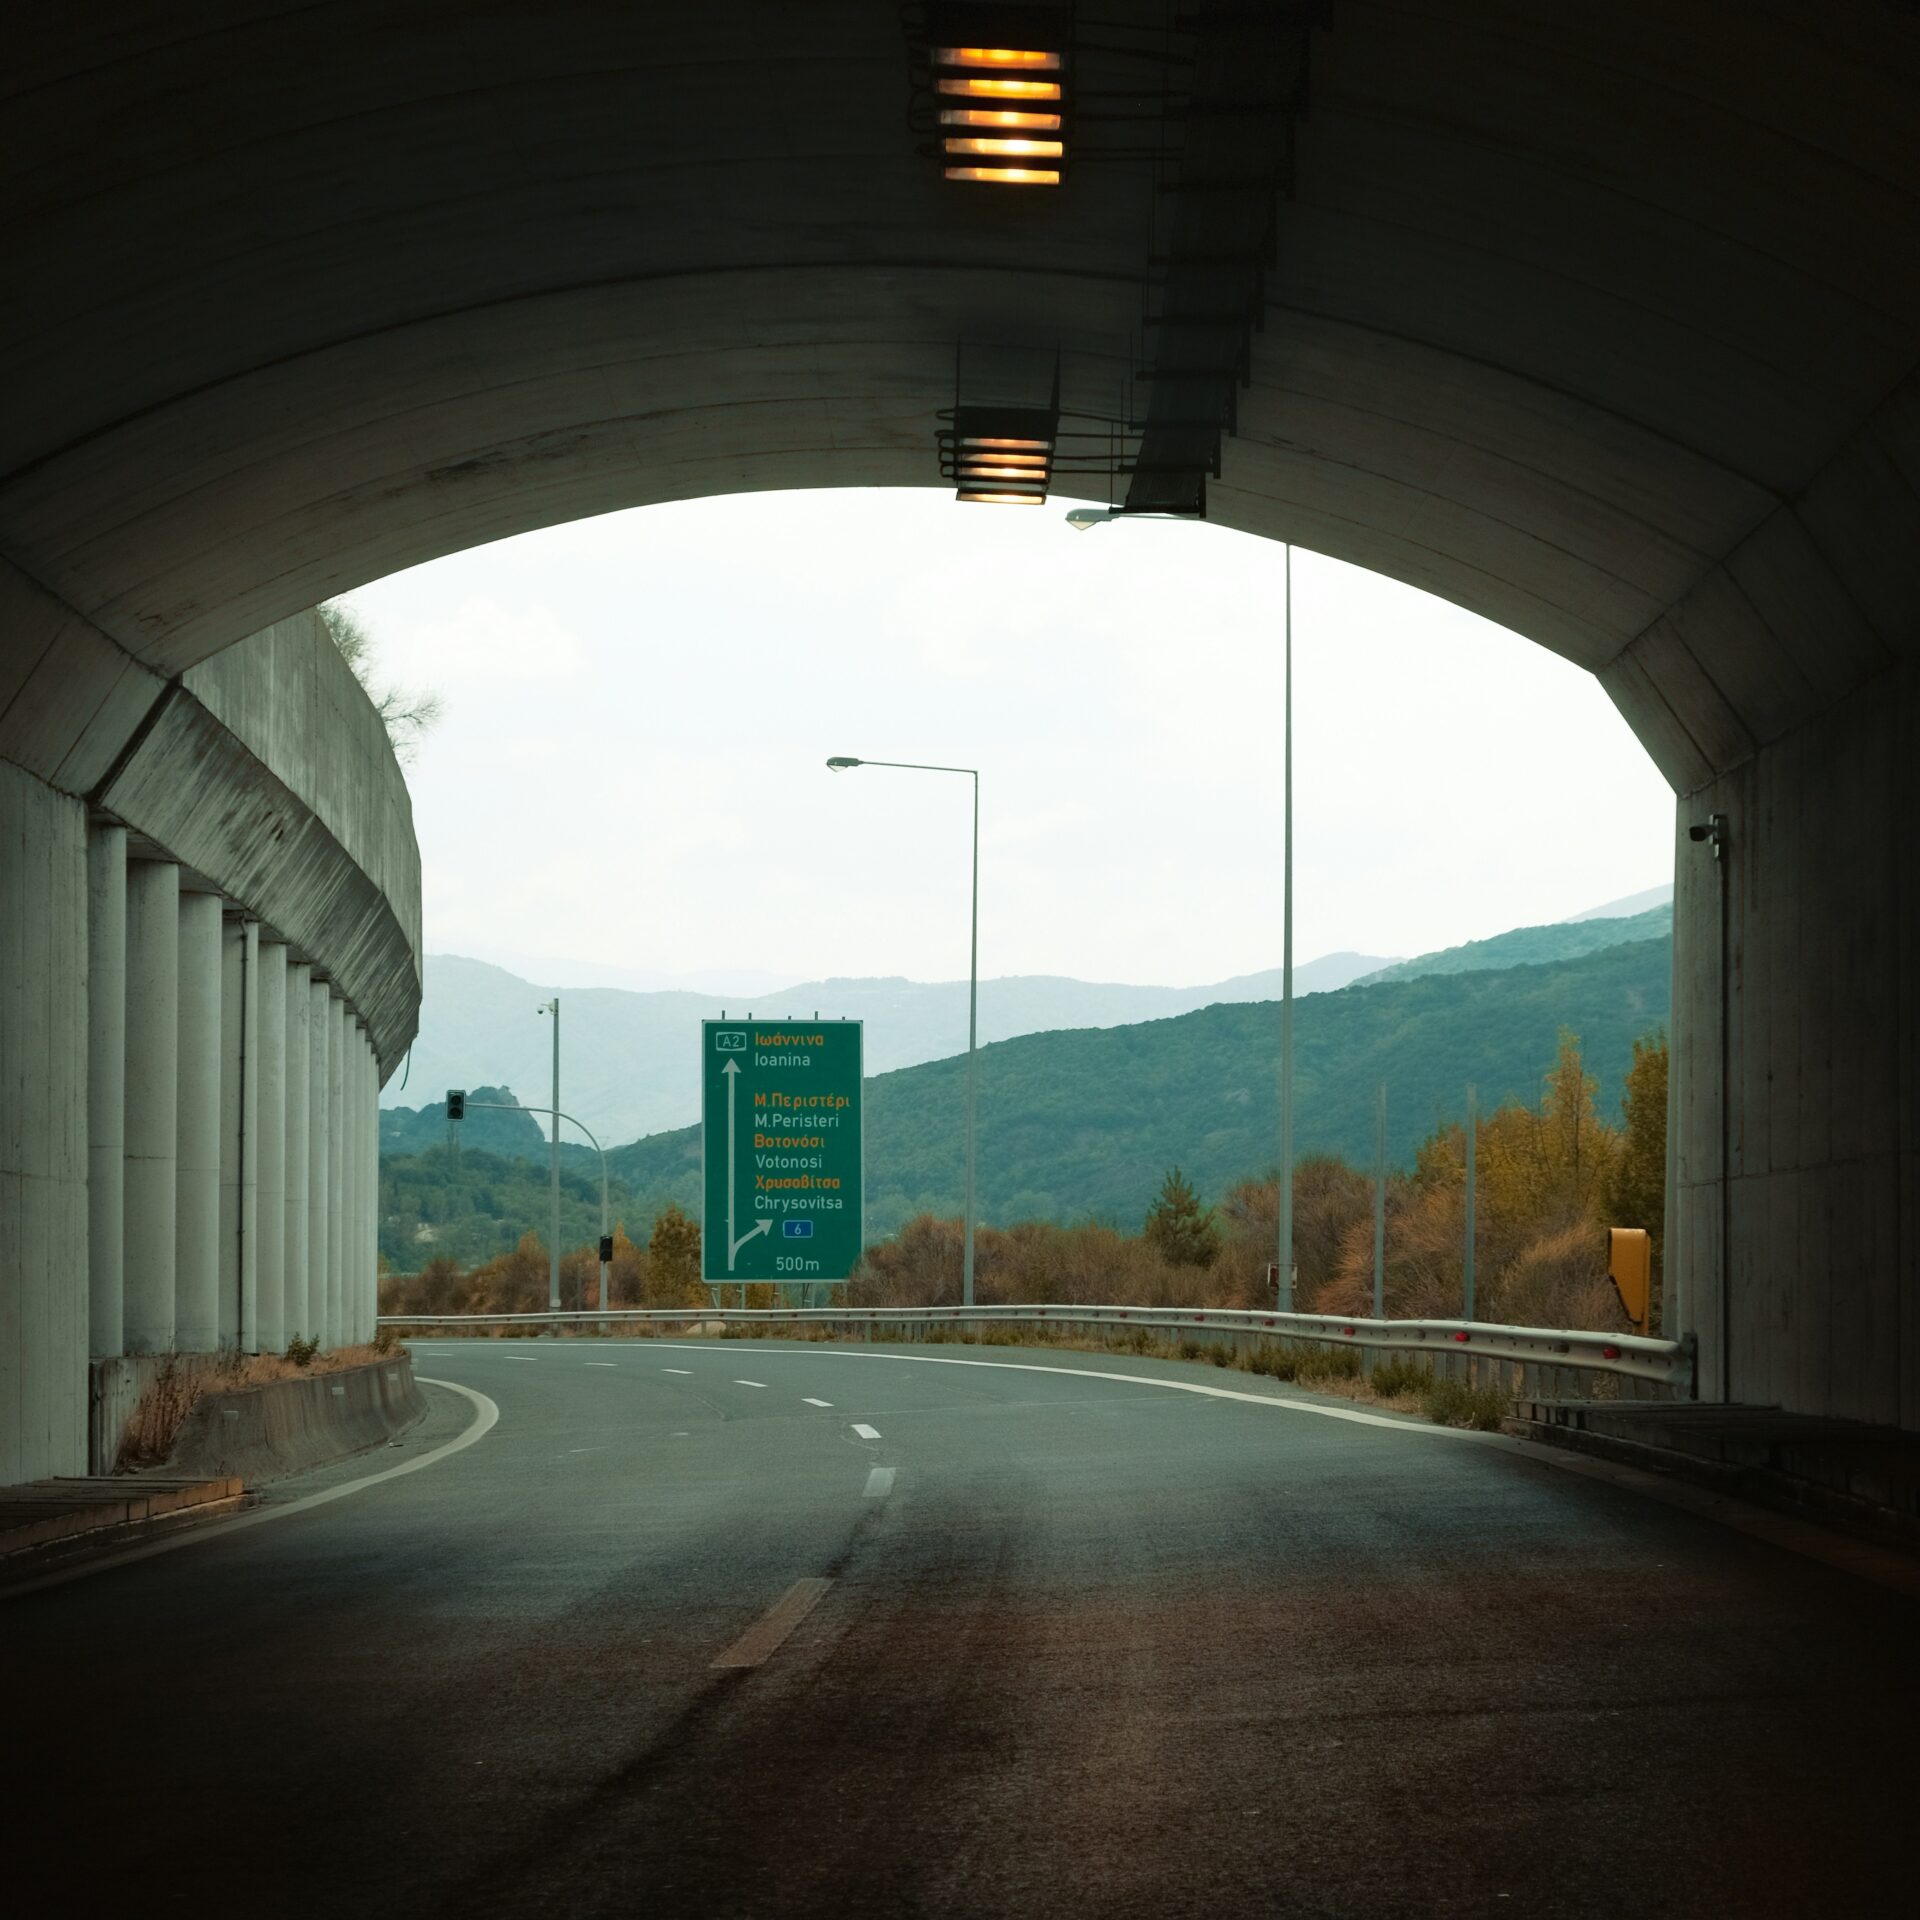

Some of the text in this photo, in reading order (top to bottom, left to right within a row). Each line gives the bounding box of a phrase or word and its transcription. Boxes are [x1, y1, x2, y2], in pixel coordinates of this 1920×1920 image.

[722, 1036, 740, 1048] A2
[755, 1032, 824, 1046] Ιωάννινα
[755, 1052, 811, 1066] Ioanina
[755, 1113, 839, 1128] M.Peristeri
[754, 1133, 825, 1148] Βοτονόσι
[755, 1154, 822, 1169] Votonosi
[755, 1174, 840, 1192] Χρυσοβίτσα
[754, 1195, 843, 1213] Chrysovitsa
[794, 1223, 802, 1235] 6
